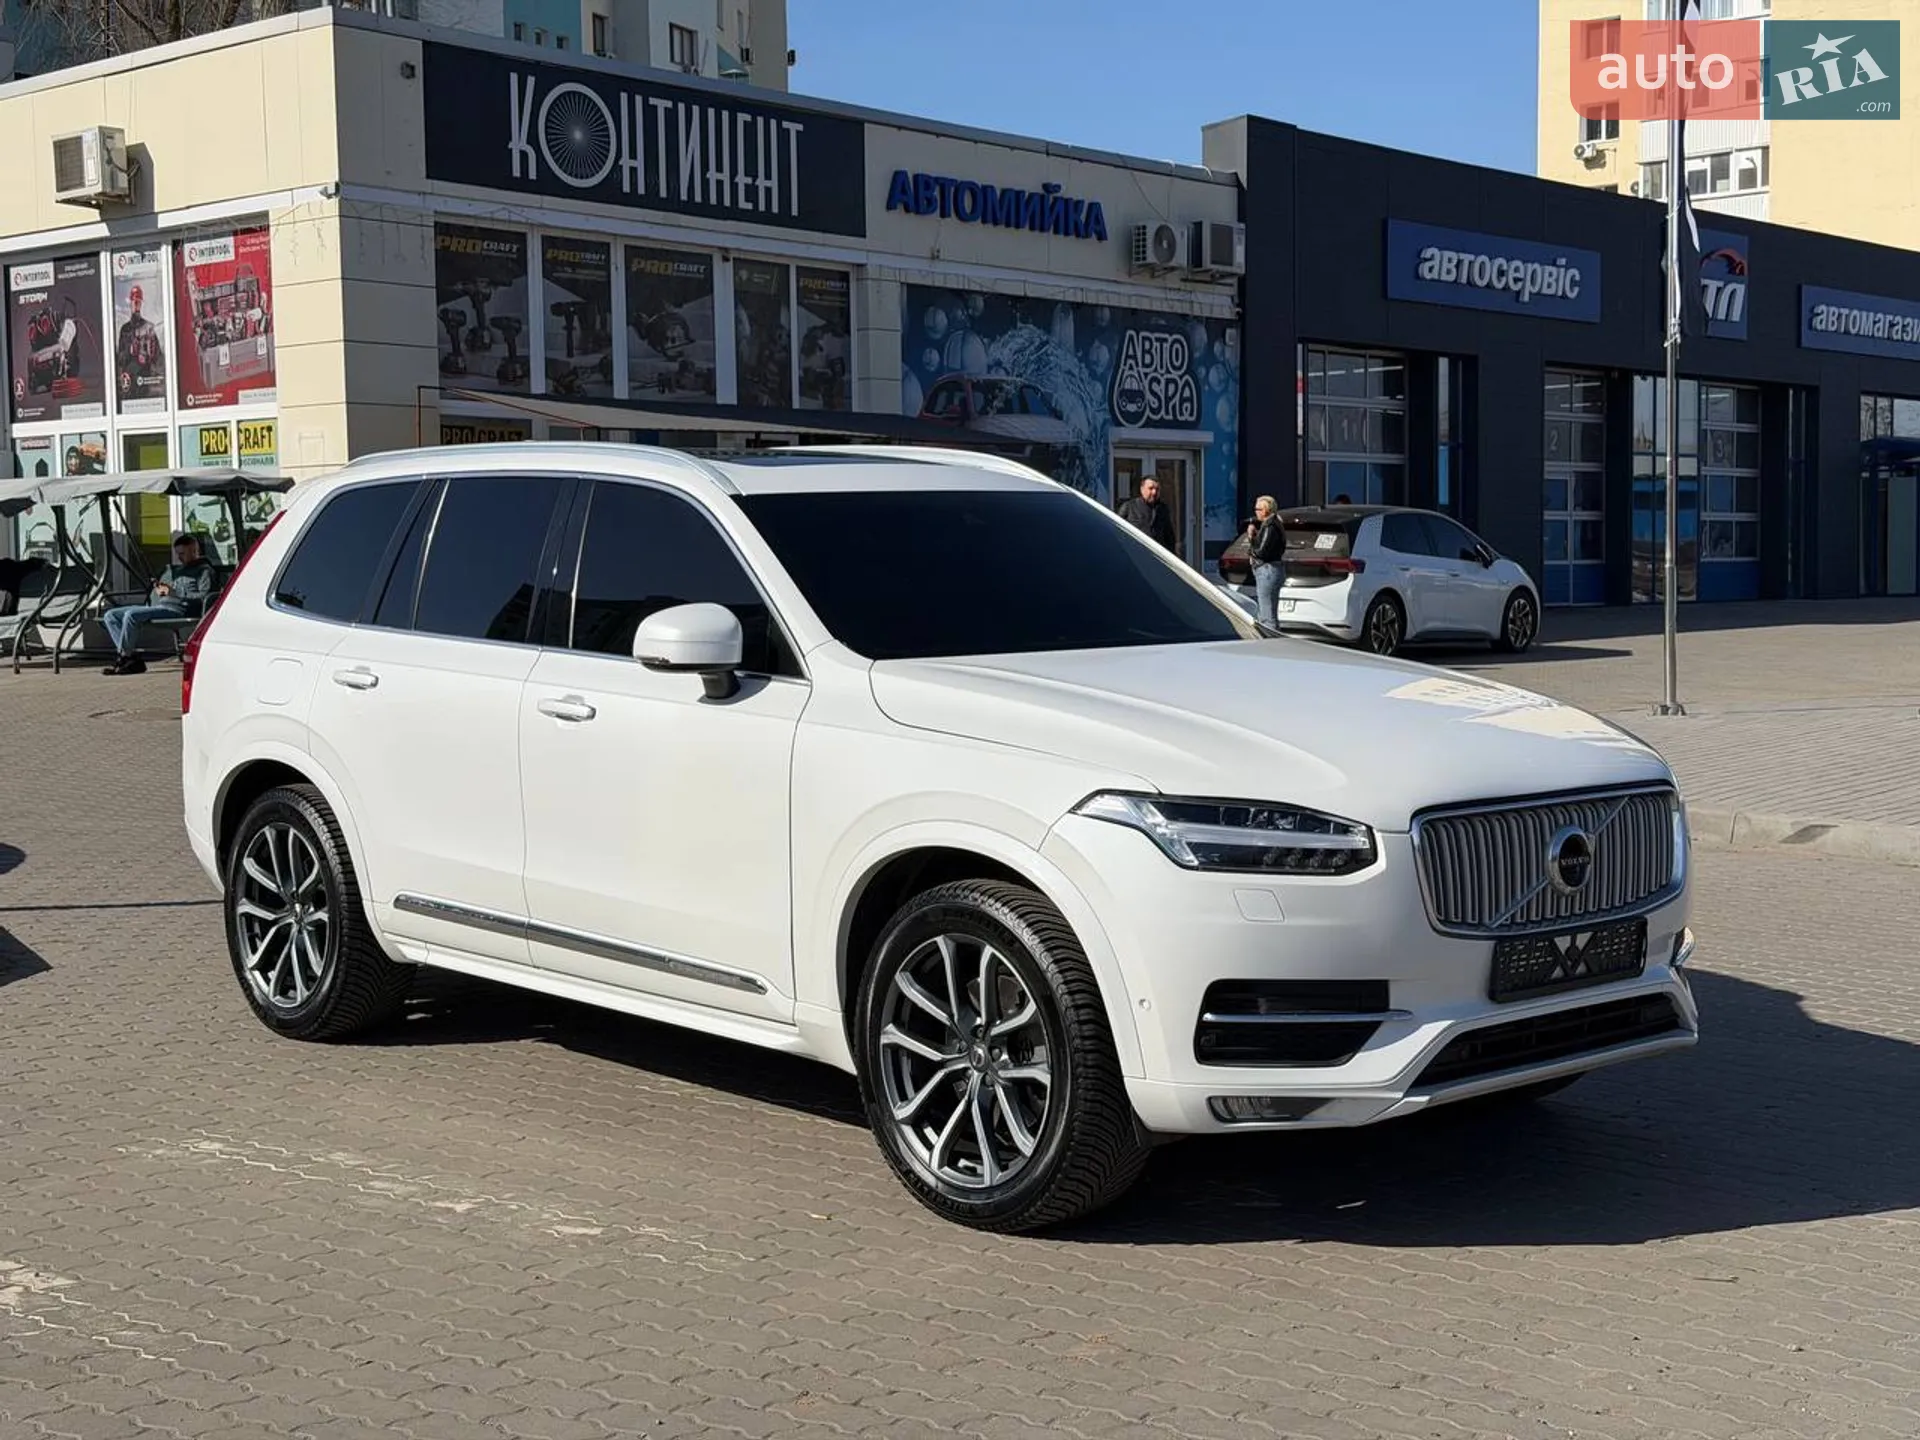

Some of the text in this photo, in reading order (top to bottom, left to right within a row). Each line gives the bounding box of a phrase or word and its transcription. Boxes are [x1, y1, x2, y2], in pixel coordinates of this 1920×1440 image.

[508, 71, 804, 217] КОНТИНЕНТ
[885, 168, 1108, 242] АВТОМИЙКА
[198, 244, 231, 259] INTERTOOL
[436, 234, 482, 253] PRO
[546, 248, 580, 264] PRO
[630, 256, 673, 276] PRO
[22, 269, 51, 284] INTERTOOL
[1418, 245, 1581, 304] автосервіс
[1146, 374, 1198, 423] SPA
[201, 428, 226, 454] PRO
[1549, 428, 1559, 451] 2
[1561, 855, 1590, 866] VOLVO
